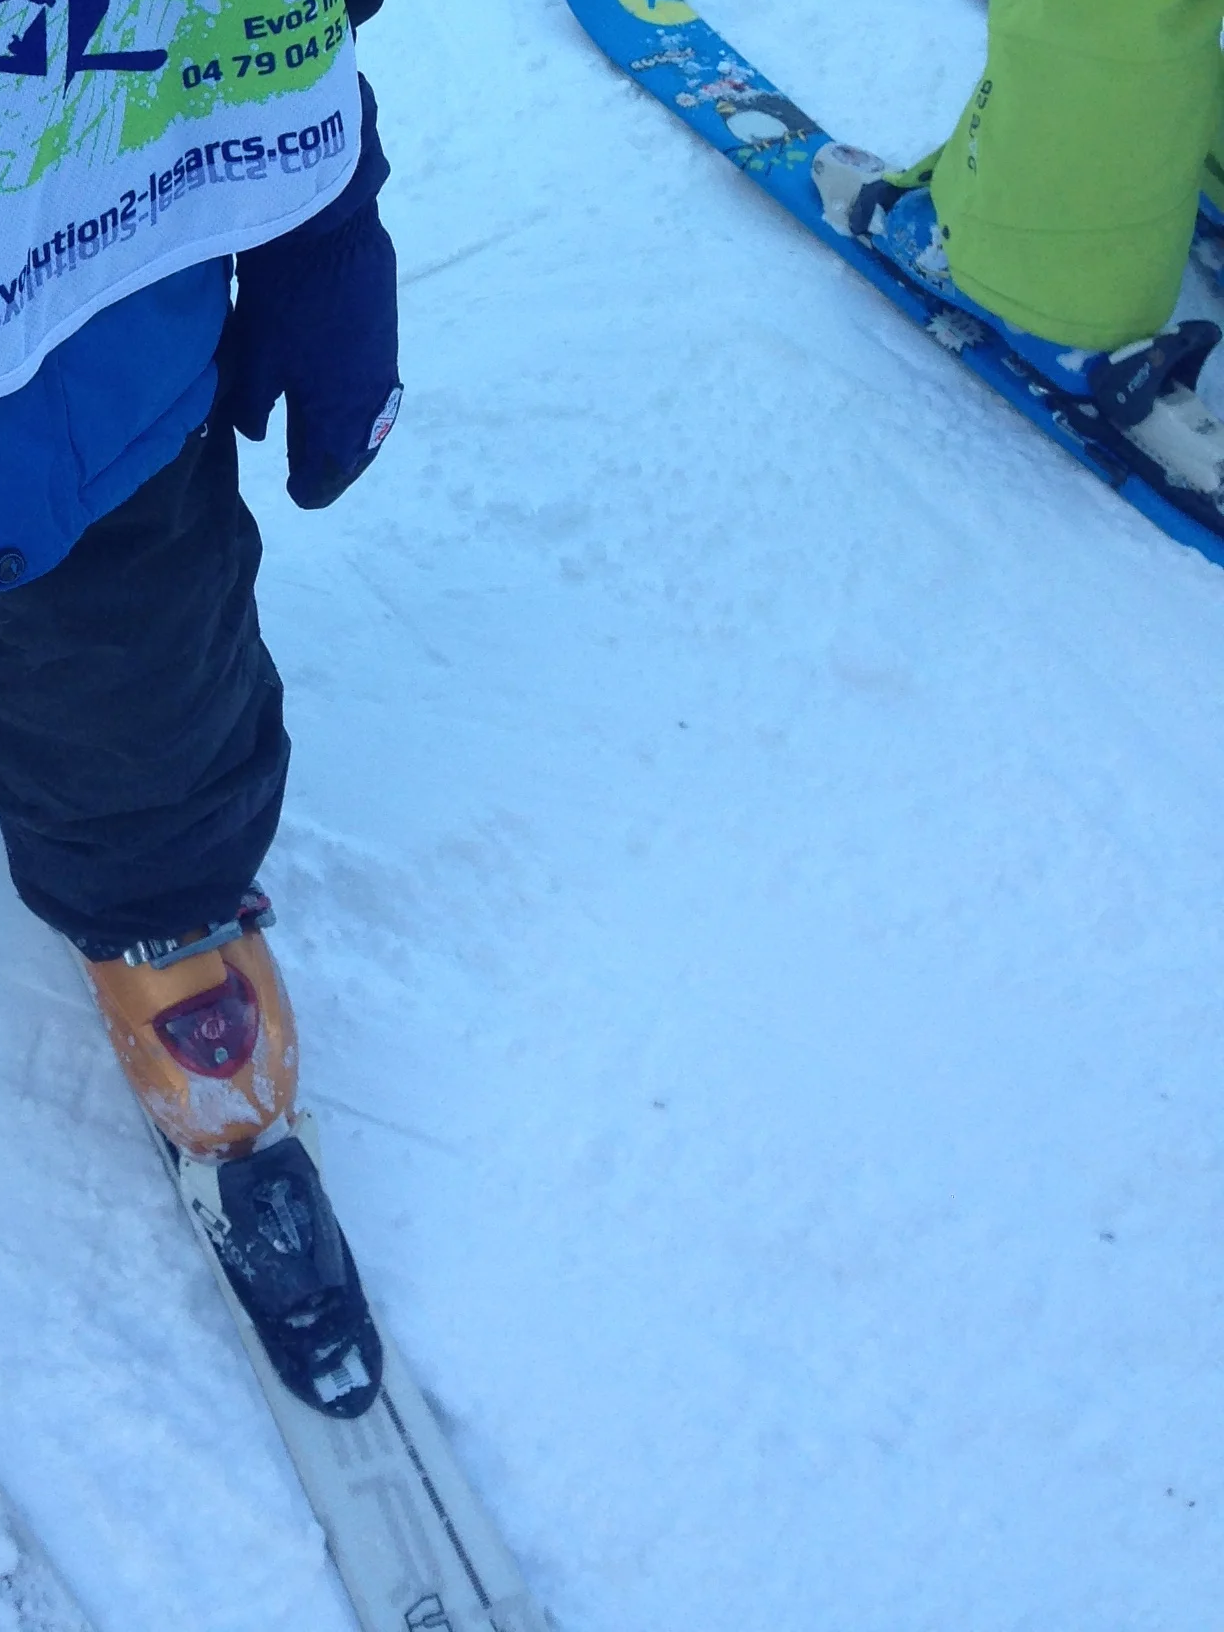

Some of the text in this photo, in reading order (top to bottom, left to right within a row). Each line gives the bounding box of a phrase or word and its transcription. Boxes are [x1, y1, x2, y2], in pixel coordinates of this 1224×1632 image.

[182, 59, 223, 89] 04
[232, 51, 276, 78] 79
[285, 36, 319, 69] 04
[323, 17, 344, 52] 25
